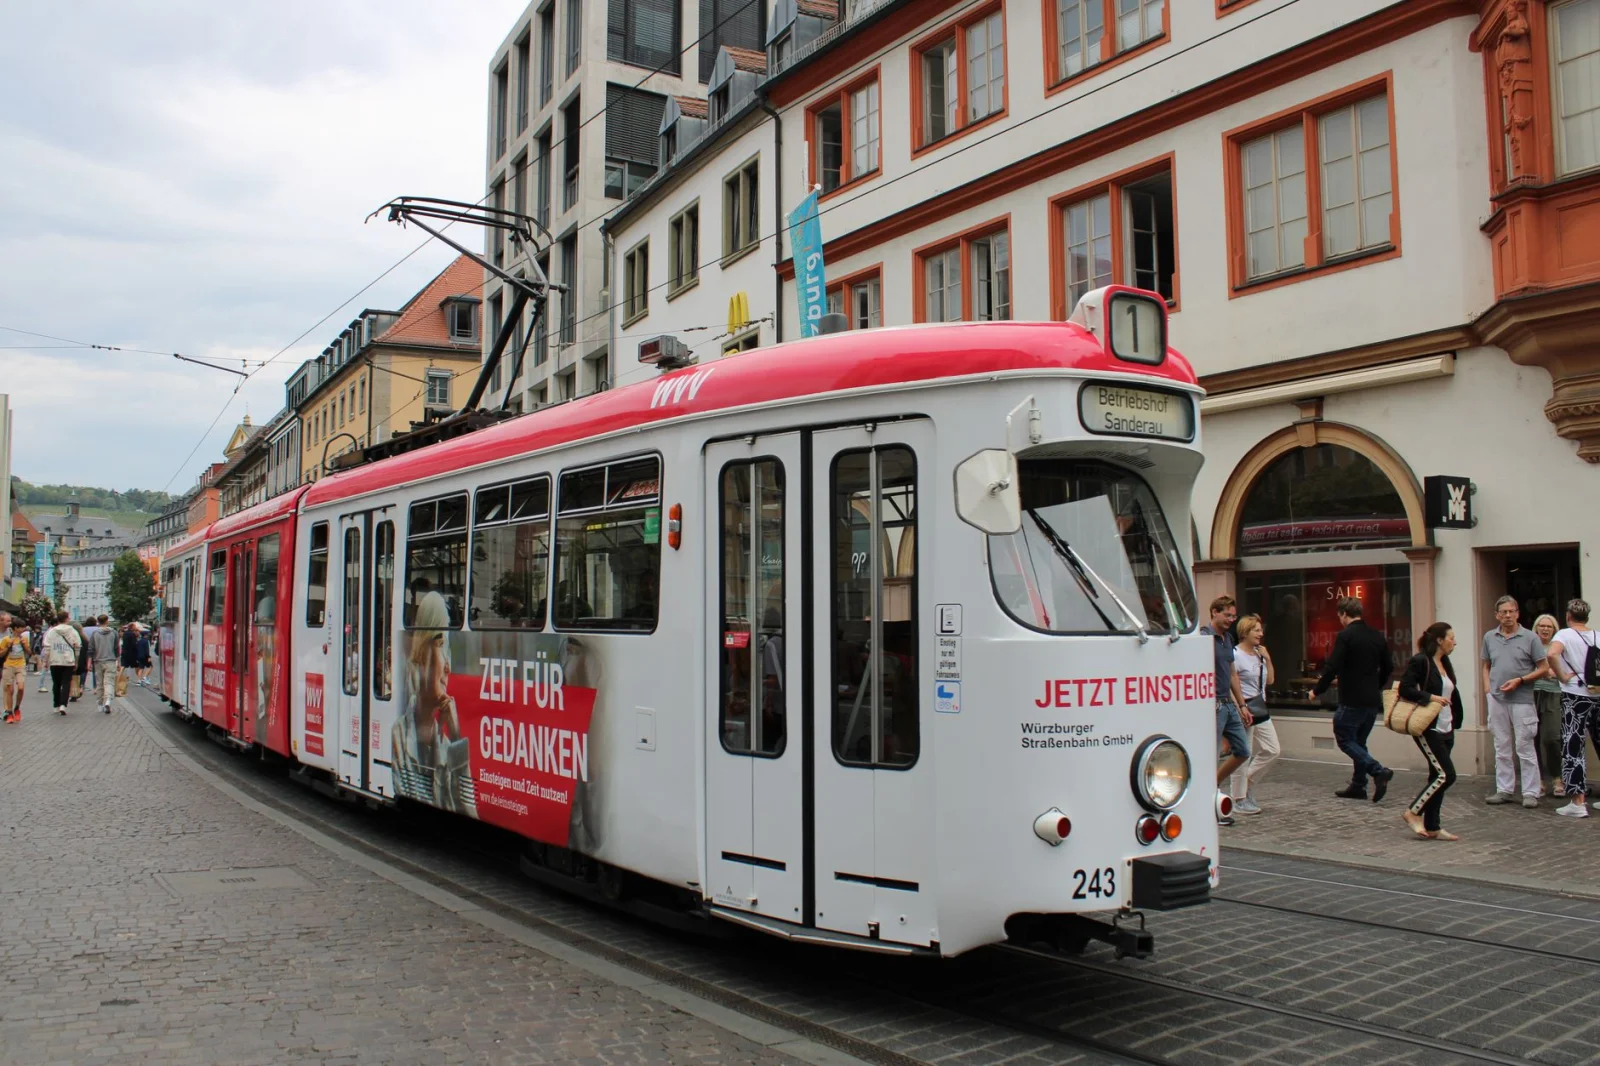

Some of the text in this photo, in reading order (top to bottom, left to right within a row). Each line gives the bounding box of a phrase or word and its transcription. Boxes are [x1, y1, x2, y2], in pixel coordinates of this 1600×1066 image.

[1126, 304, 1139, 353] 1
[1098, 387, 1169, 413] Betriebshof
[1104, 412, 1163, 435] Sanderau
[1326, 585, 1363, 600] SALE
[479, 651, 564, 711] ZEIT FÜR
[1035, 672, 1216, 709] JETZT EINSTEIGE
[1021, 722, 1095, 736] Würzburger
[1021, 734, 1134, 749] Straßenbahn GmbH
[479, 715, 588, 782] GEDANKEN
[479, 768, 568, 805] Einsteigen und Zeit nutzen!
[1072, 867, 1116, 900] 243
